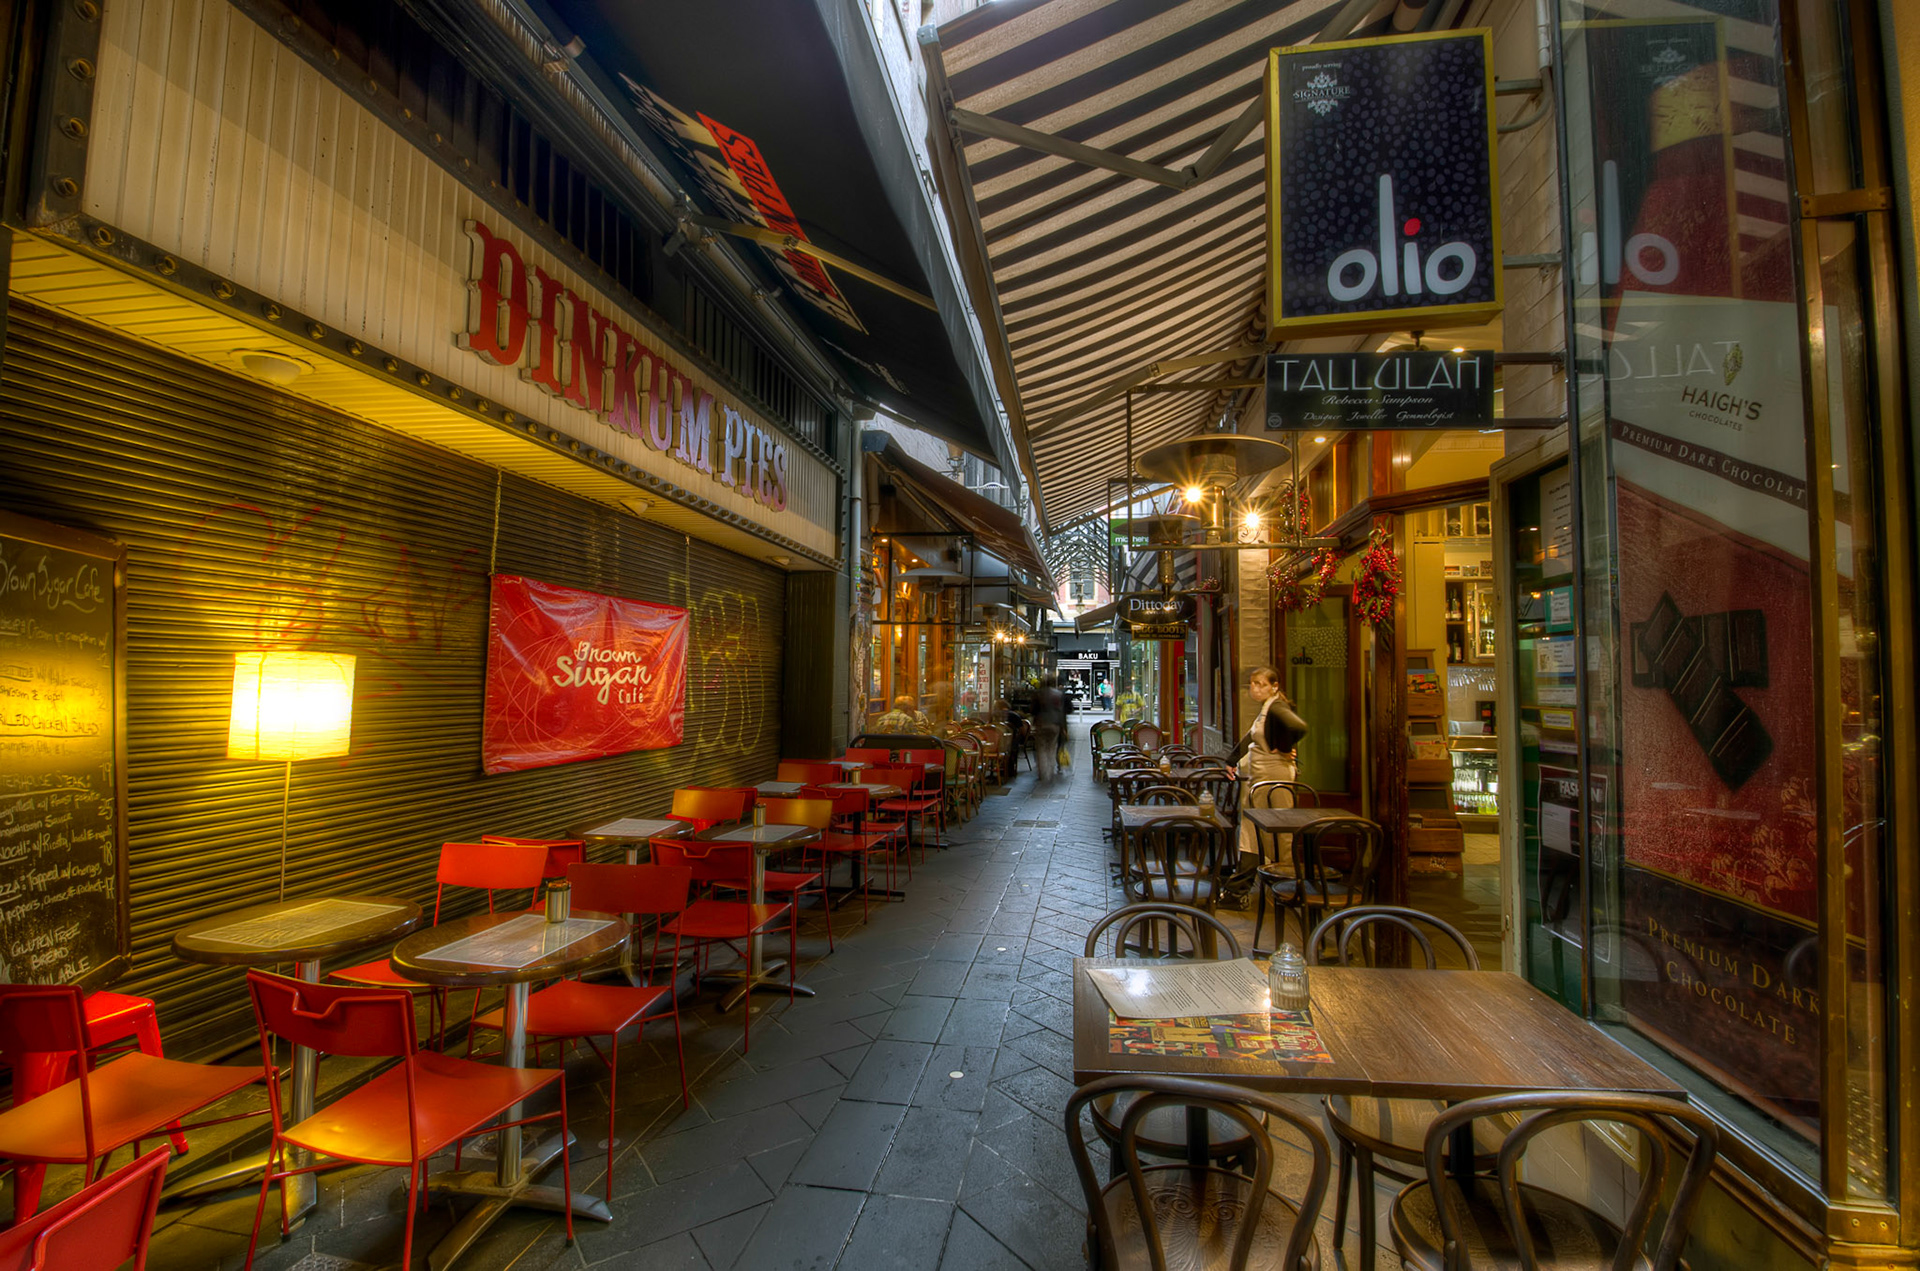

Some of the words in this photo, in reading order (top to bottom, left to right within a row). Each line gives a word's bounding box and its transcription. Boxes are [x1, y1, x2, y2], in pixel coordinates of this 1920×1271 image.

[1293, 86, 1351, 99] SIGNATURE
[711, 124, 782, 205] PIES
[1327, 173, 1477, 302] olio
[458, 219, 714, 475] DINKUM
[713, 401, 787, 512] PIES
[1275, 356, 1480, 391] TALLULAH
[1303, 412, 1342, 427] Designer
[1346, 408, 1388, 422] Jeweller
[1321, 394, 1373, 405] Rebecca
[1375, 393, 1433, 407] Sampson
[1681, 386, 1763, 421] HAIGH'S
[1688, 410, 1743, 432] CHOCOLATES
[1621, 426, 1672, 454] PREMIUM
[1678, 444, 1716, 468] DARK
[38, 556, 74, 610] Sugar
[574, 641, 642, 663] Brown
[552, 655, 652, 705] Sugar
[618, 687, 644, 704] Café
[1559, 780, 1602, 804] FASHN
[11, 929, 55, 957] GLUTEN
[54, 921, 80, 943] FREE
[31, 946, 69, 971] BREAD
[1648, 916, 1738, 977] PREMIUM
[1752, 963, 1820, 1016] DARK
[1666, 961, 1797, 1045] CHOCOLATE
